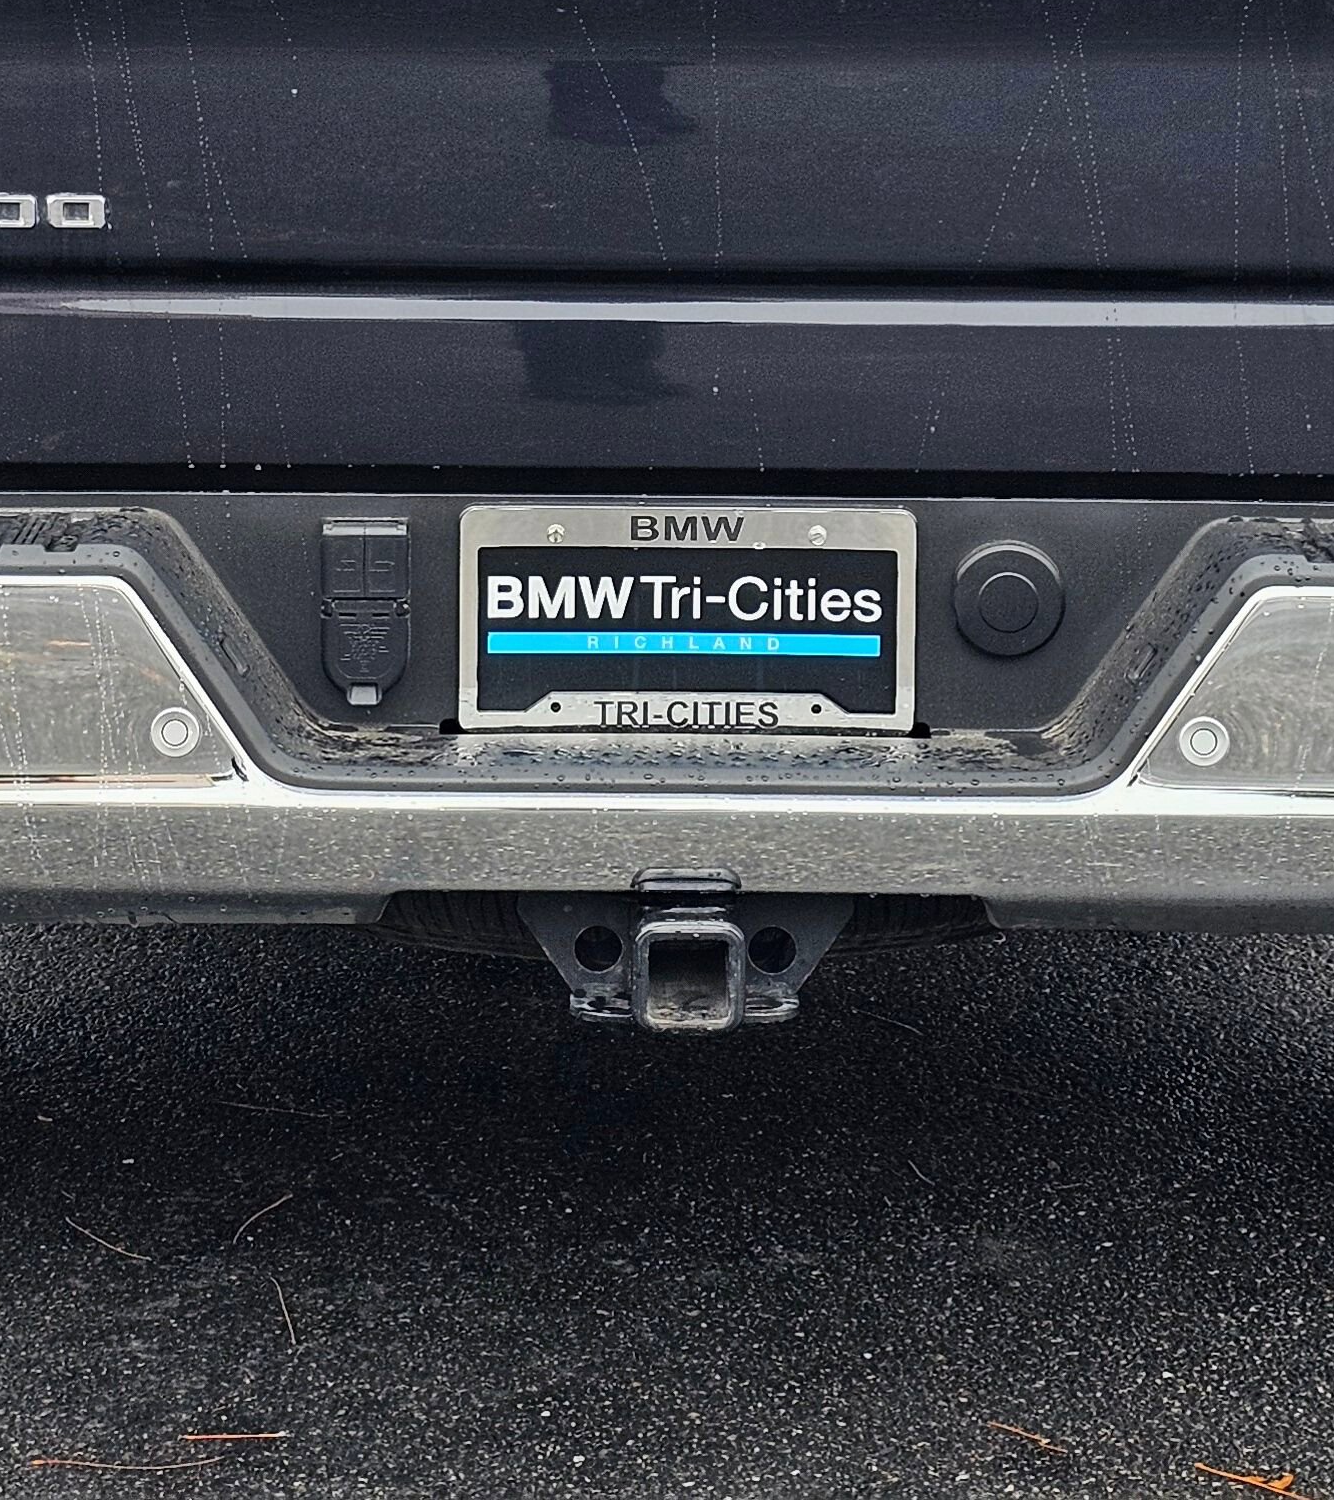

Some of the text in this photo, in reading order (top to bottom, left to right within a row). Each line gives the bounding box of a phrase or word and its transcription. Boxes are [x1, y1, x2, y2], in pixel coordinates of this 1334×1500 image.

[630, 515, 744, 542] BMW
[487, 575, 883, 622] BMW Tri-Cities
[587, 635, 781, 652] RICHLAND
[594, 700, 779, 729] TRI-CITIES
